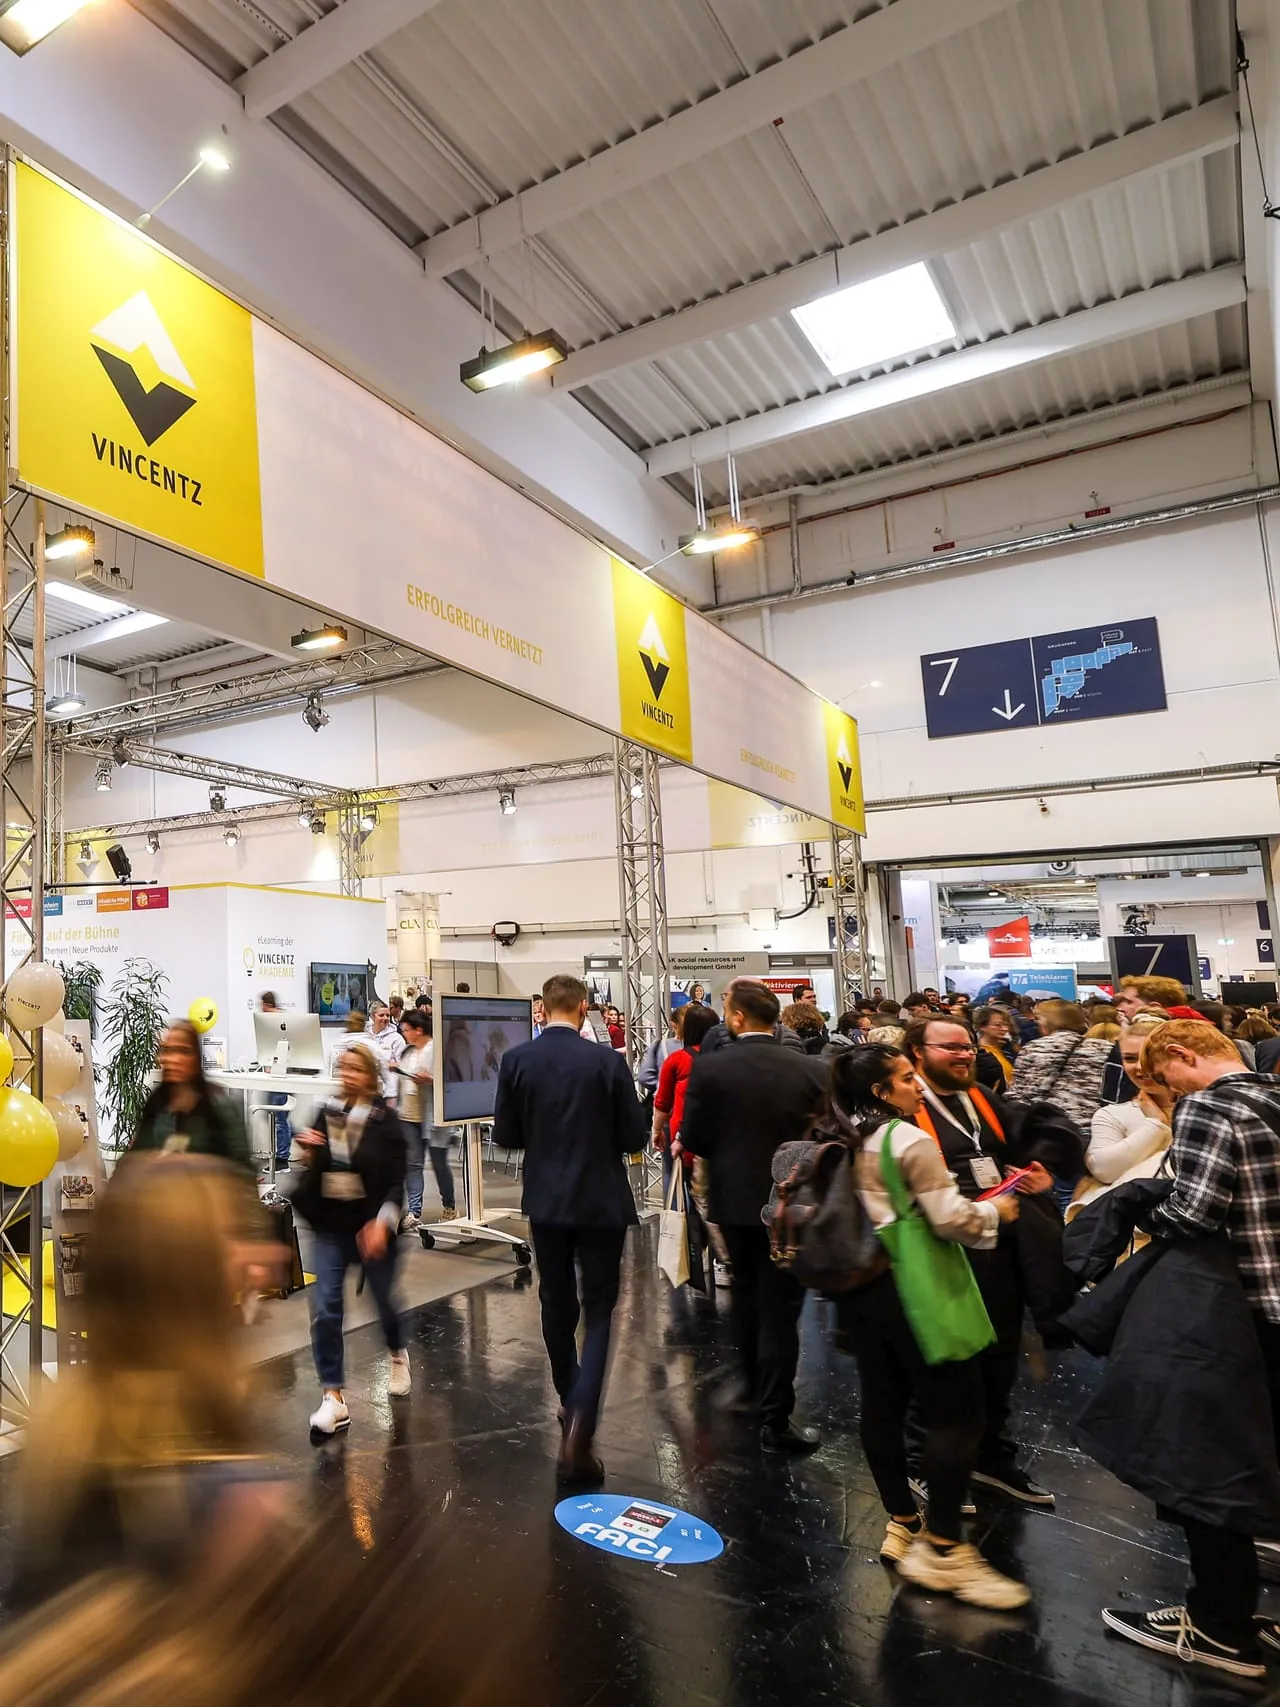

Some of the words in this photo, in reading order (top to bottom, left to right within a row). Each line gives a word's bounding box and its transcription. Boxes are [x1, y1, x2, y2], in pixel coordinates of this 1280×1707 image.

[92, 432, 202, 506] VINCENTZ
[407, 583, 489, 641] ERFOLGREICH
[492, 625, 543, 666] VERNETZT
[930, 657, 959, 696] 7
[641, 700, 674, 729] VINCENTZ
[46, 927, 63, 942] auf
[65, 928, 82, 940] der
[85, 926, 120, 939] Bühne
[72, 946, 88, 954] Neue
[90, 945, 119, 953] Produkte
[1260, 941, 1269, 952] 6
[258, 954, 294, 964] VINCENTZ
[1135, 943, 1164, 976] 7
[259, 966, 294, 977] AKADEMIE
[18, 997, 40, 1010] VINCENTZ
[573, 1522, 673, 1561] FACI
